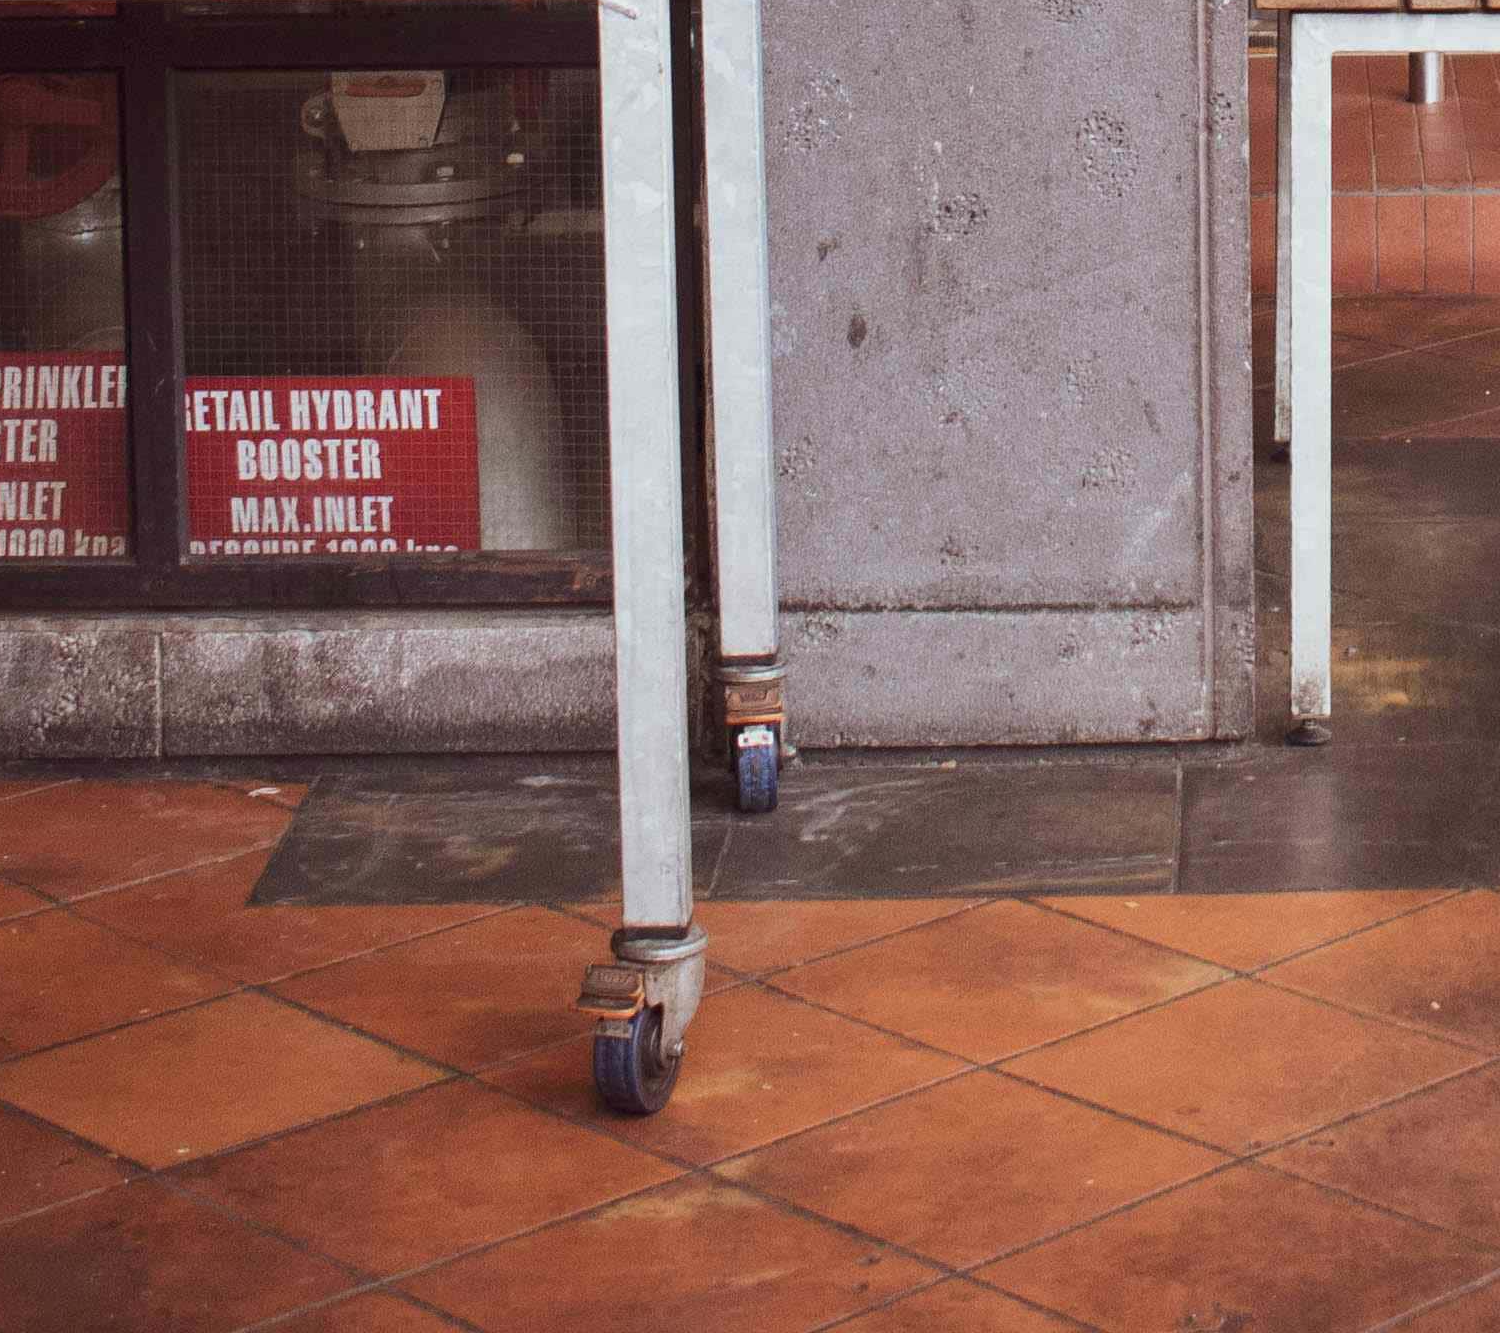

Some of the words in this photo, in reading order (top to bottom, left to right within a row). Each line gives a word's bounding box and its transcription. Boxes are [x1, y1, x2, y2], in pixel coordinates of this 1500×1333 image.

[289, 388, 442, 431] HYDRANT
[236, 437, 382, 481] BOOSTER
[230, 495, 394, 533] MAX.INLET
